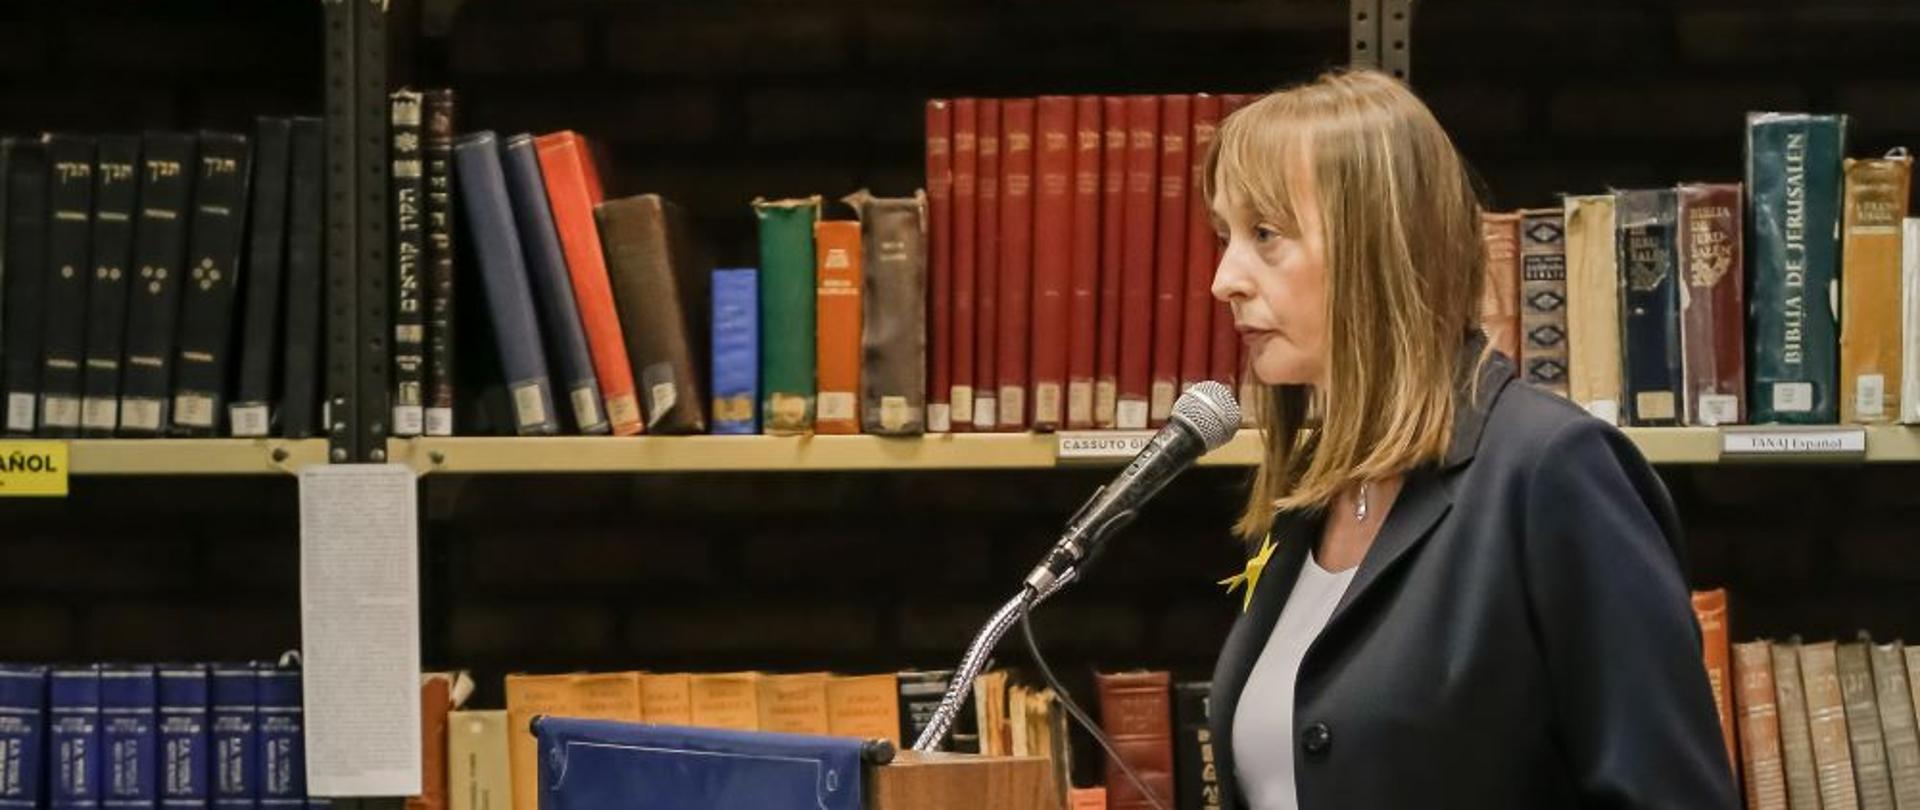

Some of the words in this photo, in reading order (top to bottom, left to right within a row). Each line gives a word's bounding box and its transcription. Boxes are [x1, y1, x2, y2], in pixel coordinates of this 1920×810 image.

[1785, 260, 1802, 286] DE
[1784, 297, 1802, 363] BIBLIA
[1063, 440, 1126, 449] CASSUTO
